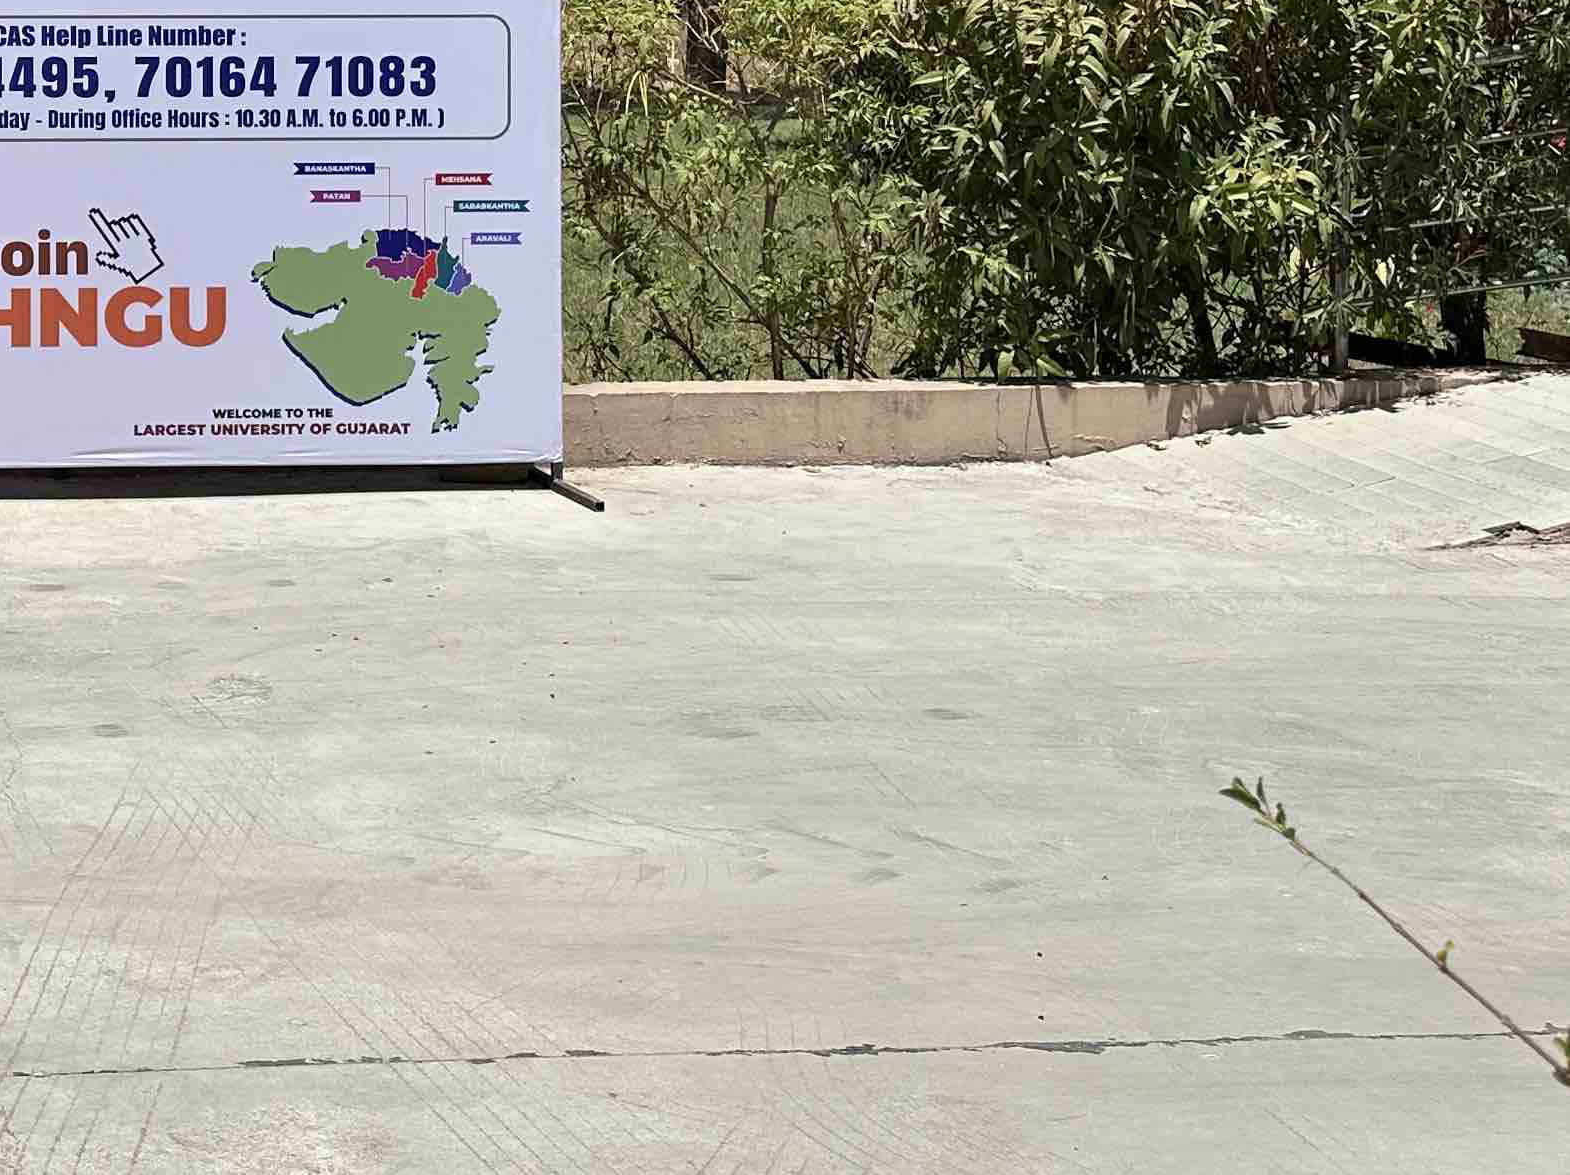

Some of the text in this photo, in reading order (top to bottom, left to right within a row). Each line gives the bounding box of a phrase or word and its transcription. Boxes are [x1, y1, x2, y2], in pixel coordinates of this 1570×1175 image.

[42, 26, 91, 48] Help
[97, 26, 142, 46] Line
[149, 26, 236, 46] Number
[135, 56, 277, 97] 70164
[296, 56, 435, 97] 71083
[49, 109, 105, 130] During
[112, 108, 162, 128] Office
[168, 110, 219, 128] Hours
[235, 109, 280, 127] 10.30
[287, 109, 323, 127] A.M.
[329, 109, 346, 127] to
[353, 109, 390, 127] 6.00
[396, 109, 432, 127] P.M.
[441, 175, 483, 184] MEHSANA
[323, 192, 351, 200] PATAN
[212, 407, 334, 419] WELCOME TO THE
[133, 422, 411, 436] LARGEST UNIVERSITY OF GUJARAT
